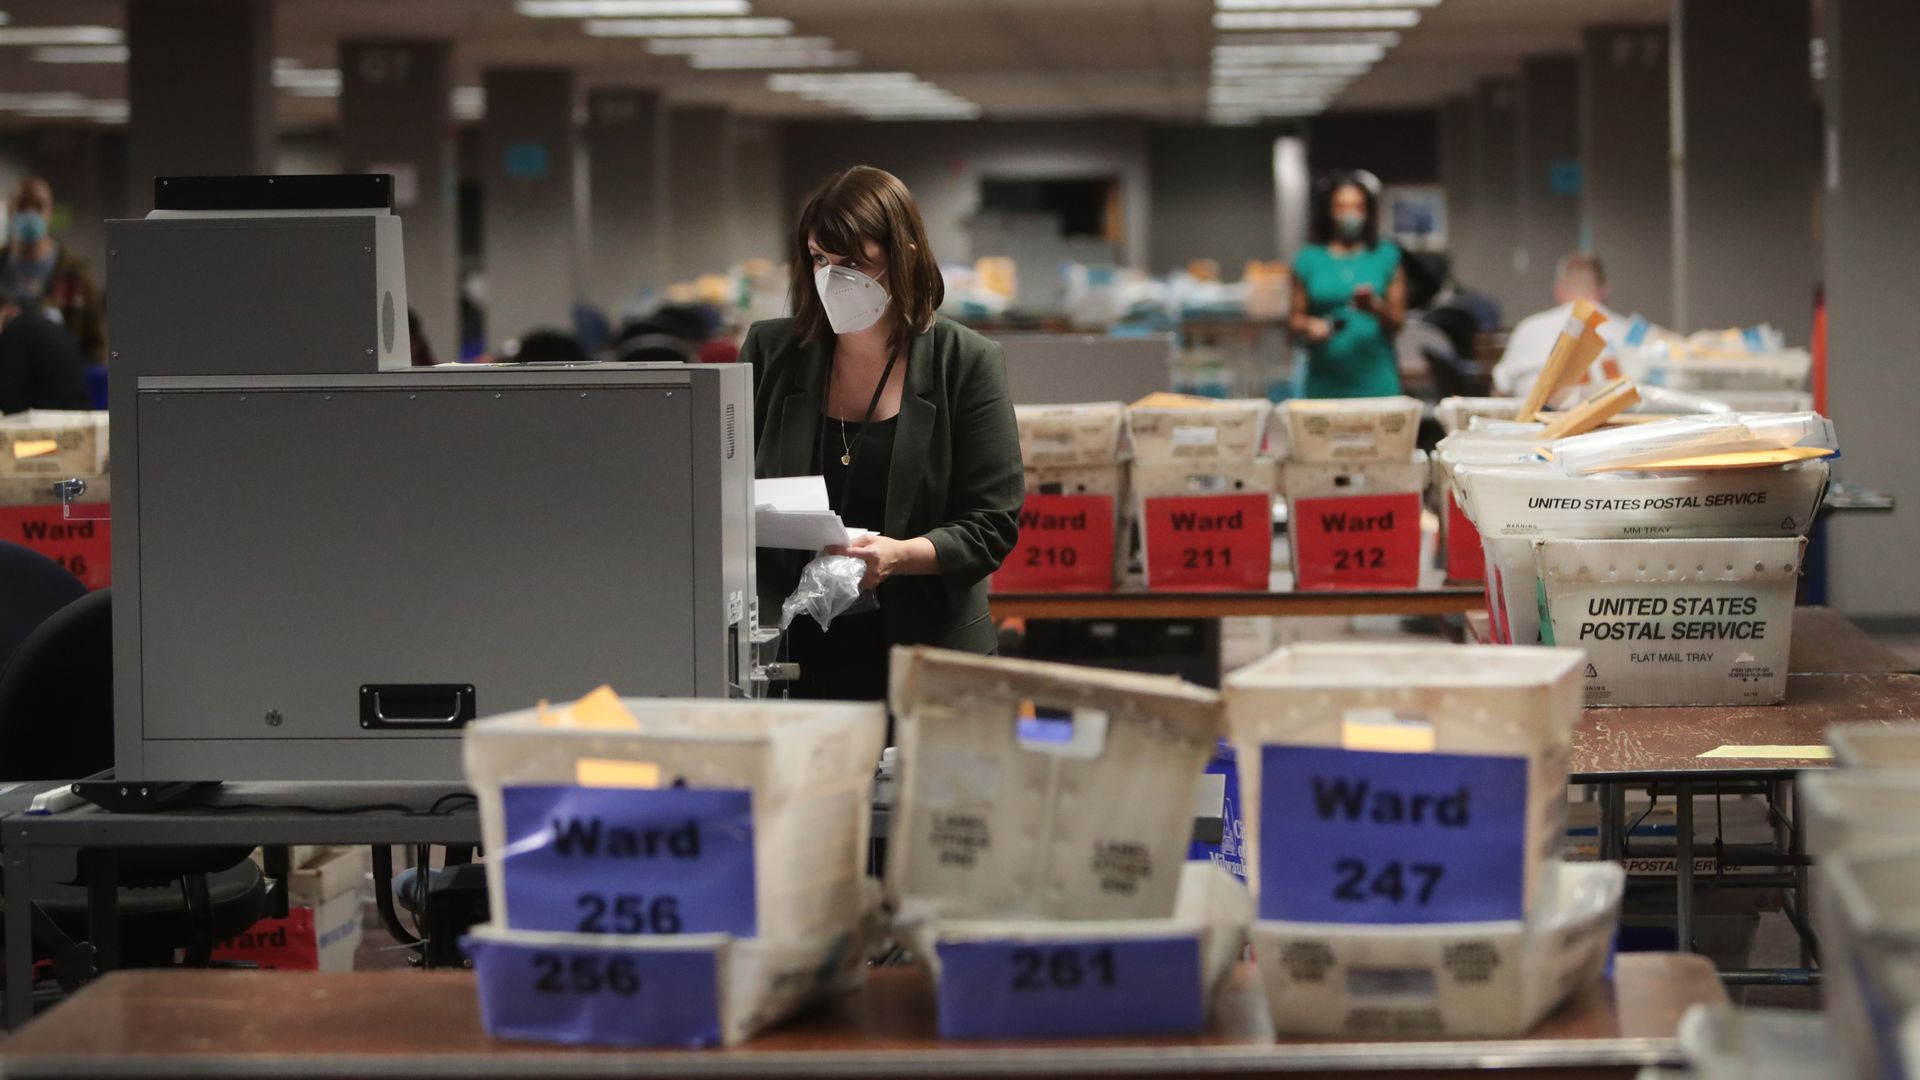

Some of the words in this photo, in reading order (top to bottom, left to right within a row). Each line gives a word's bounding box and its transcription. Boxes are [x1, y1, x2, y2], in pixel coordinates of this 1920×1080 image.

[1528, 497, 1581, 509] UNITED
[1584, 499, 1640, 510] STATES
[1643, 495, 1701, 509] POSTAL
[1704, 491, 1767, 507] SERVICE
[22, 520, 95, 540] Ward
[1018, 511, 1086, 530] Ward
[1171, 510, 1243, 531] Ward
[1320, 511, 1394, 532] Ward
[1644, 526, 1672, 534] TRAY
[1026, 548, 1076, 567] 210
[1184, 548, 1233, 568] 211
[1334, 548, 1385, 569] 212
[1588, 598, 1668, 616] UNITED
[1672, 597, 1758, 616] STATES
[1579, 622, 1666, 640] POSTAL
[1671, 621, 1766, 640] SERVICE
[1630, 653, 1656, 663] FLAT
[1658, 653, 1683, 663] MAIL
[1686, 653, 1714, 662] TRAY
[1311, 775, 1470, 829] Ward
[553, 819, 702, 859] Ward
[1333, 858, 1446, 907] 247
[575, 893, 682, 935] 256
[533, 953, 641, 998] 256
[1011, 946, 1117, 993] 261
